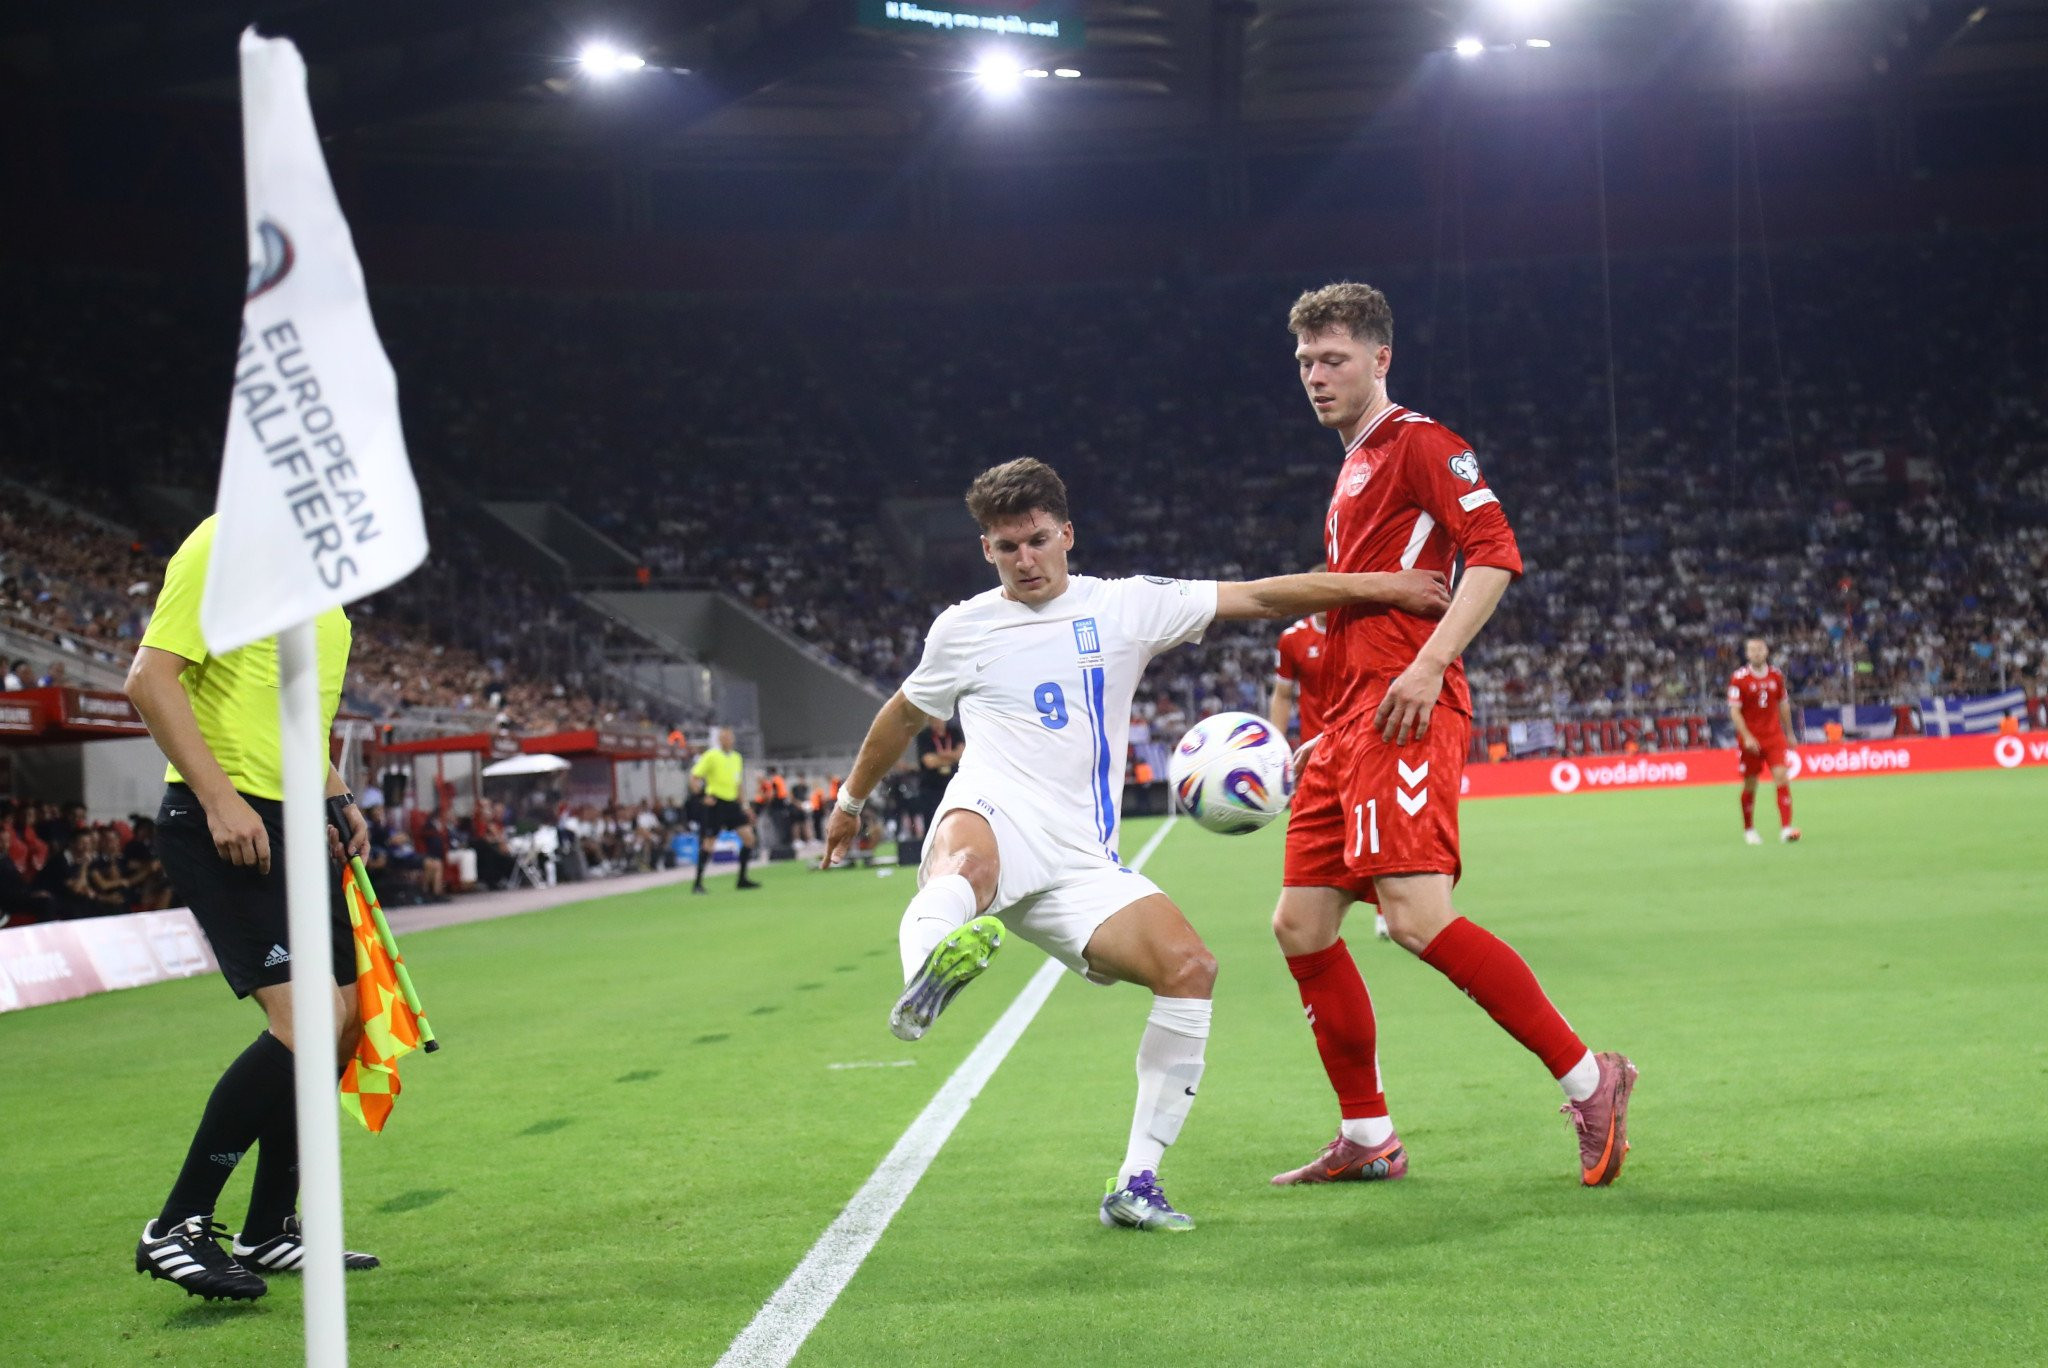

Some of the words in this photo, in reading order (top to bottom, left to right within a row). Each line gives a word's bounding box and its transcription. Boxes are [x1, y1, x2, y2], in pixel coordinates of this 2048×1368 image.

[235, 320, 358, 590] UALIFIERS
[261, 320, 381, 544] EUROPEAN
[1034, 682, 1069, 729] 9
[1585, 759, 1687, 785] vodafone
[1806, 747, 1910, 772] vodafone
[1354, 798, 1380, 857] 11
[264, 954, 291, 967] adida
